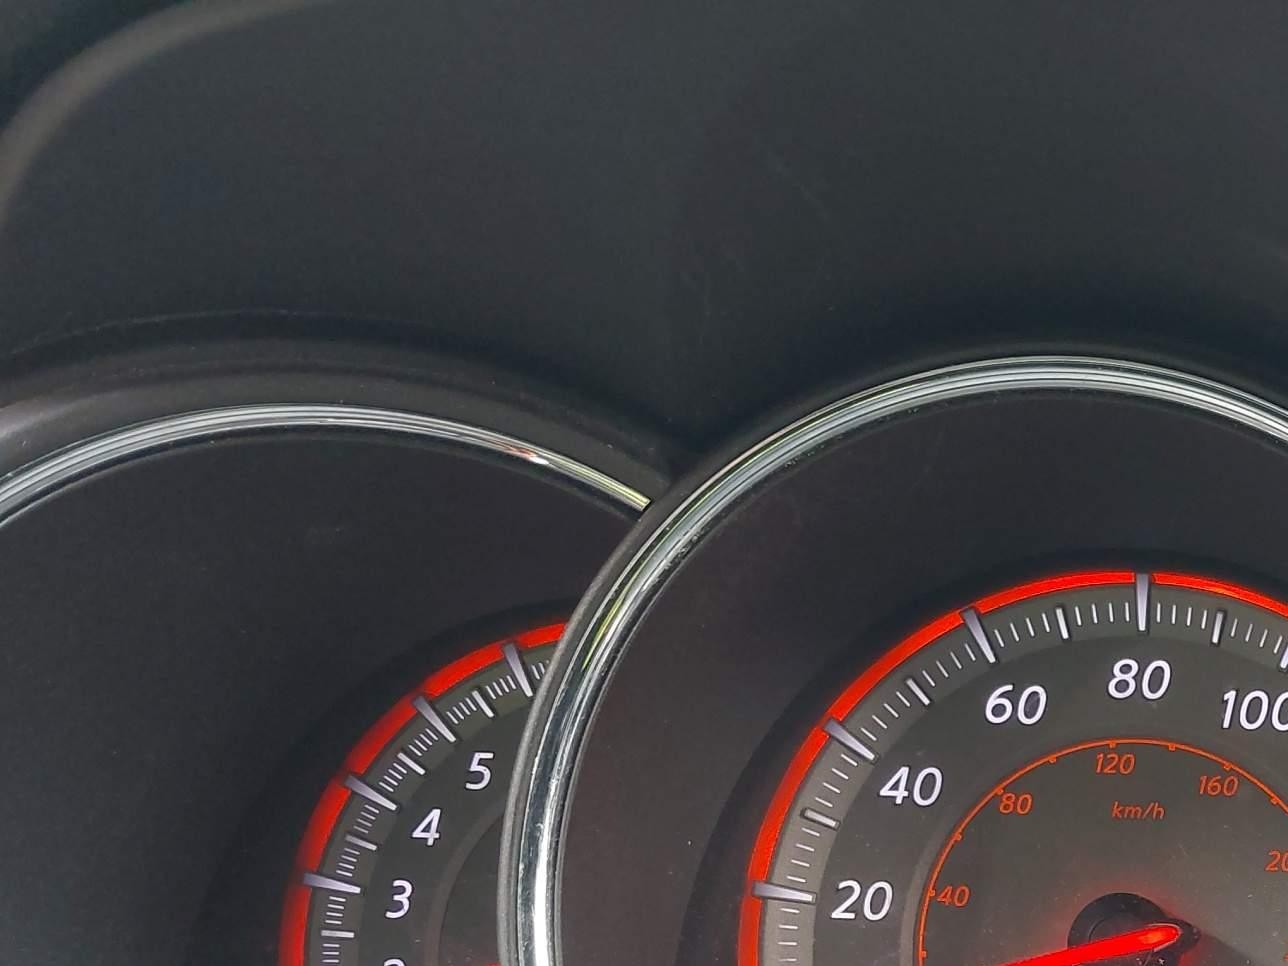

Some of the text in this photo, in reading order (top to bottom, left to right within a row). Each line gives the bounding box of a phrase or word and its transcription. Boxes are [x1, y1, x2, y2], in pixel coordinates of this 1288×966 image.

[1107, 658, 1171, 699] 80
[985, 684, 1047, 725] 60
[465, 752, 494, 790] 5
[1095, 753, 1135, 775] 120
[880, 766, 943, 806] 40
[1000, 794, 1032, 814] 80
[1200, 775, 1239, 797] 160
[412, 809, 442, 846] 4
[1111, 802, 1165, 820] km/h
[385, 880, 413, 918] 3
[831, 880, 893, 921] 20
[937, 886, 970, 907] 40
